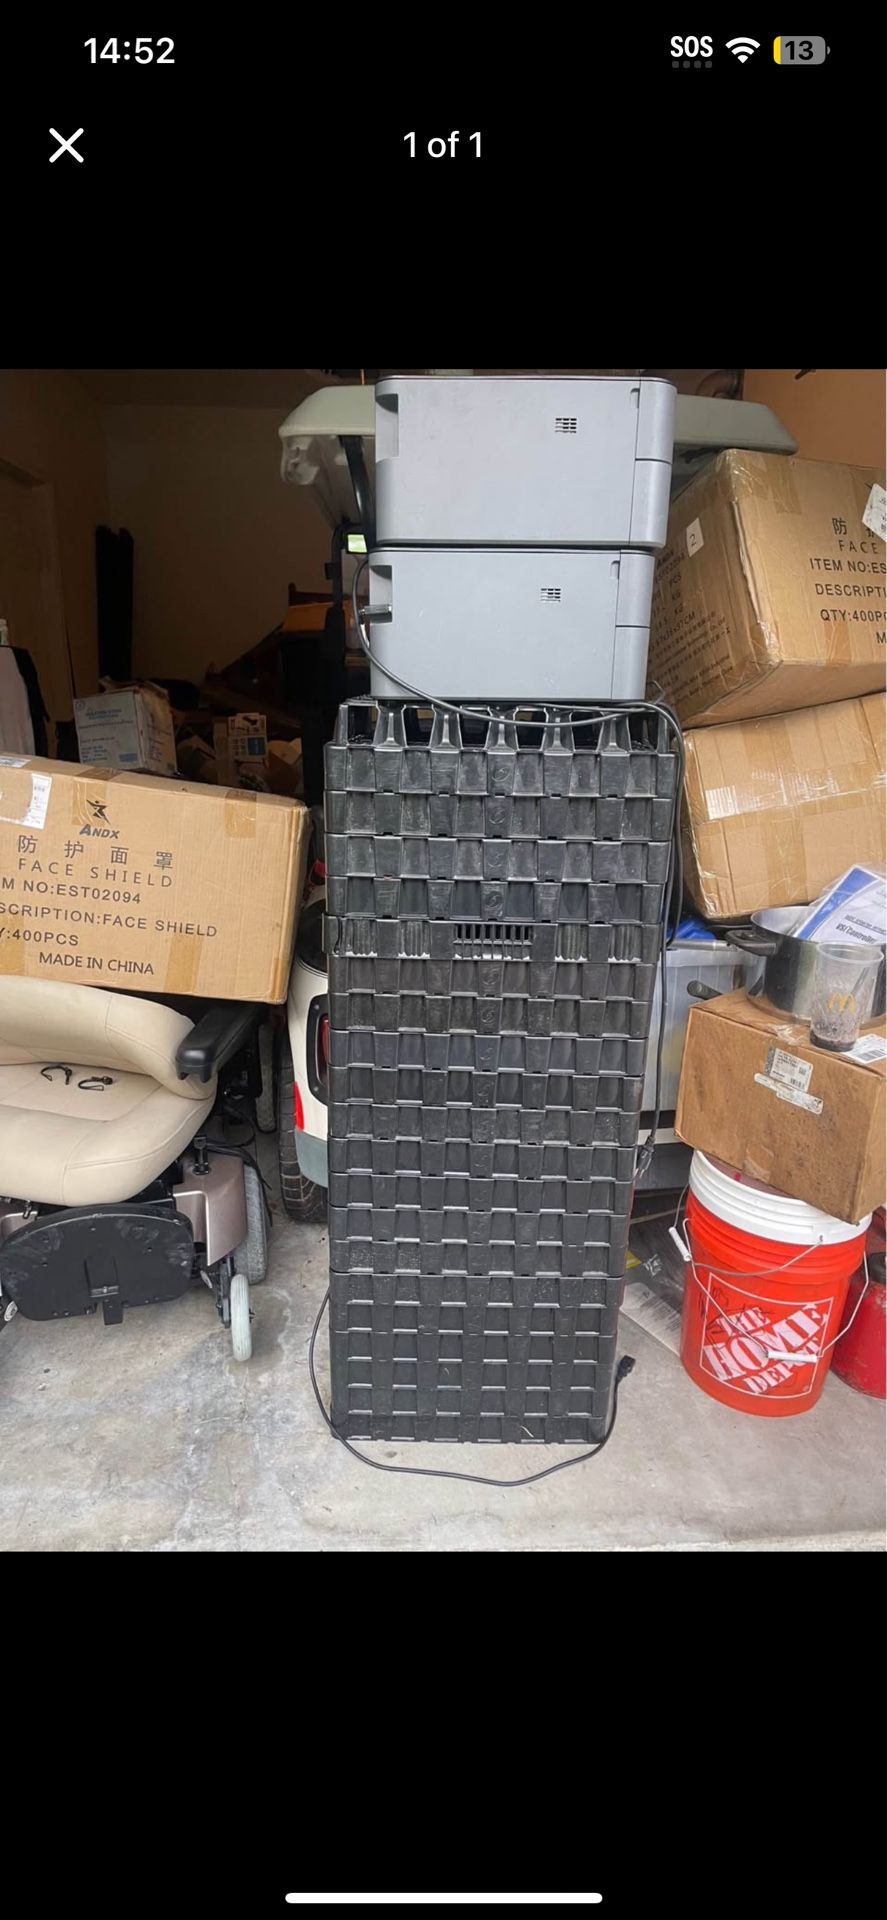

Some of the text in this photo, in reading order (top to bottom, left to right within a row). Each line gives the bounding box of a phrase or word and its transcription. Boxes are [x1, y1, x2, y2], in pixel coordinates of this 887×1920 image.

[838, 539, 879, 555] FACE
[809, 557, 843, 572] ITEM
[18, 857, 173, 888] FACE SHIELD
[23, 879, 141, 905] NO:EST02094
[155, 919, 218, 938] SHIELD
[39, 951, 155, 976] MADE IN CHINA
[715, 1306, 771, 1338] THE
[702, 1302, 829, 1382] HOME
